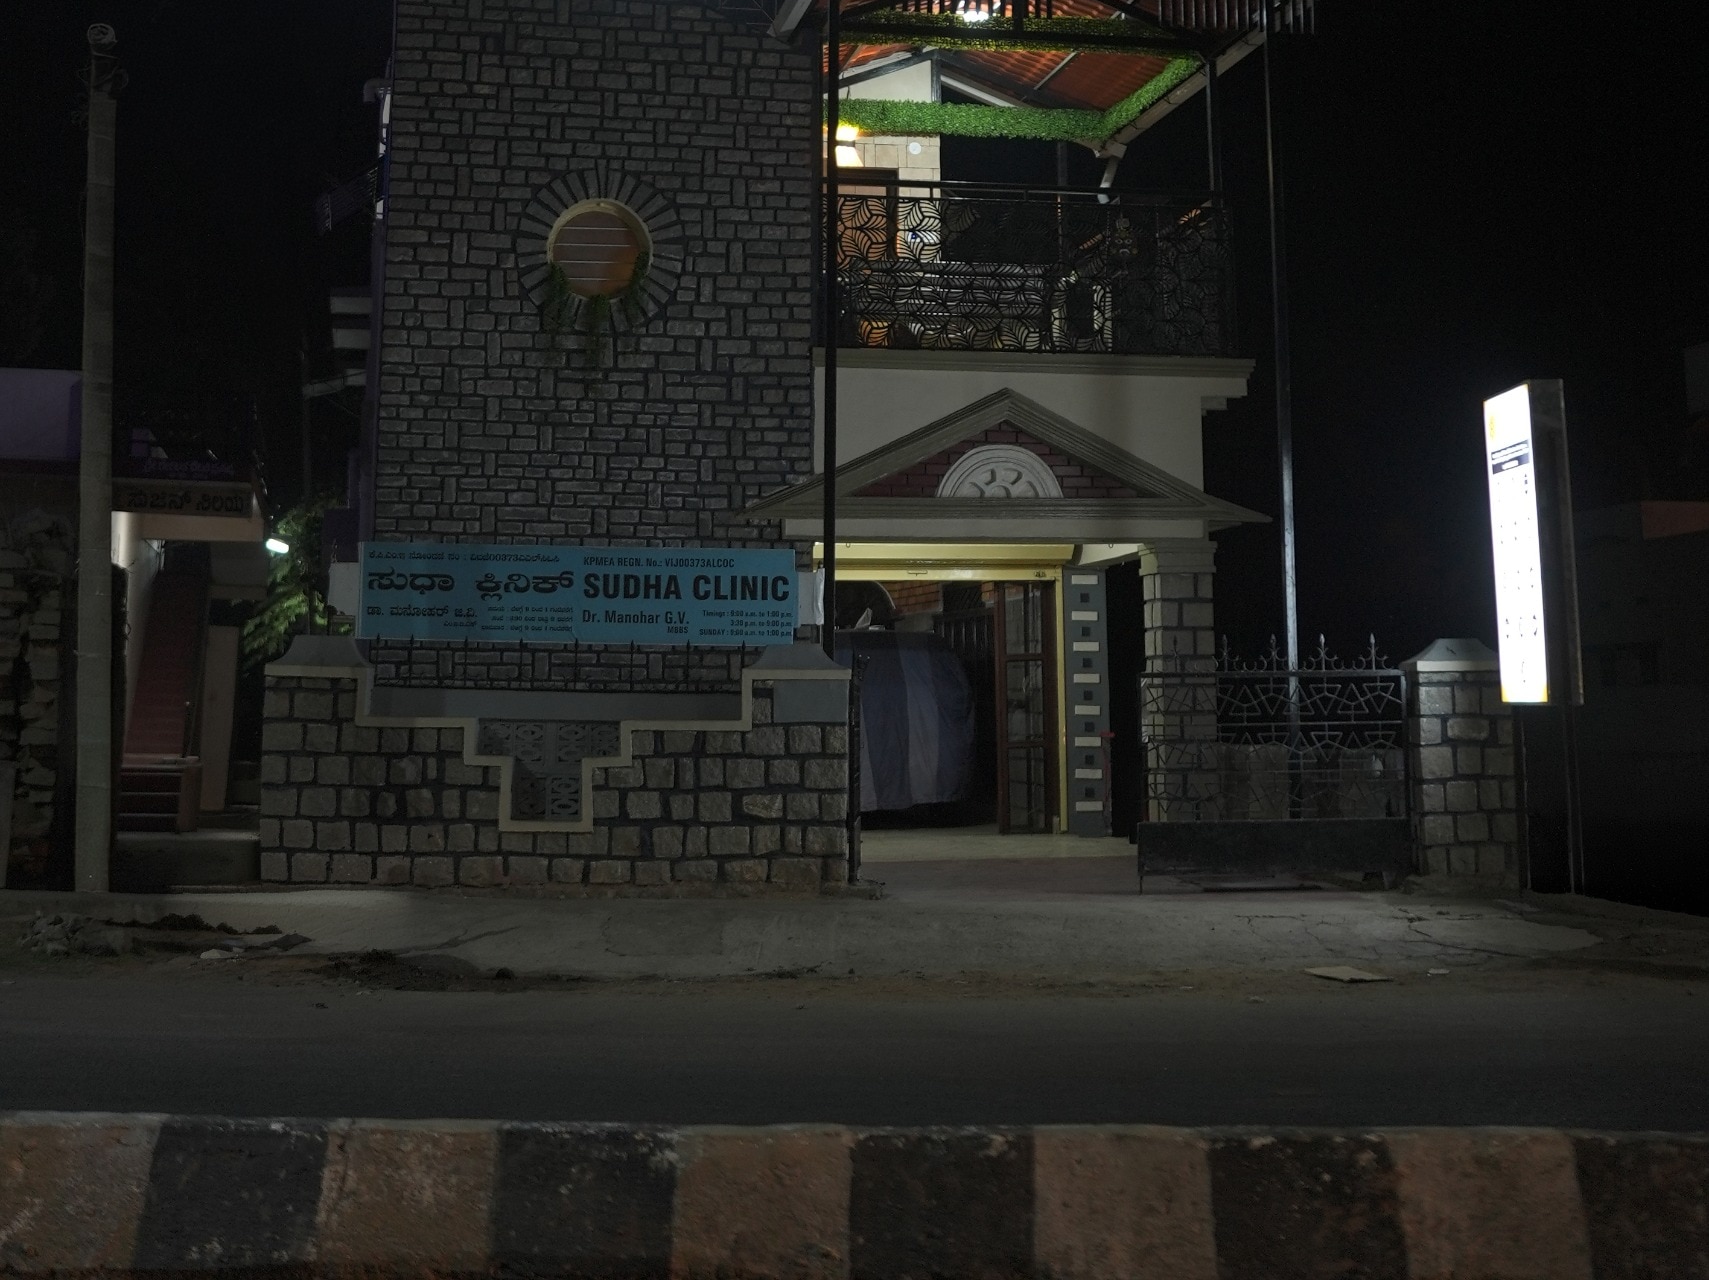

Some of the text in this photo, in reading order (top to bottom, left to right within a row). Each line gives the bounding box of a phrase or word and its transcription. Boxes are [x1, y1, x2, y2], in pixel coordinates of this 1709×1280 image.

[584, 556, 615, 566] KPMEA
[617, 557, 644, 567] REGN.
[368, 567, 574, 601] ಸುಧಾ ಕ್ಲಿನಿಕ್
[583, 573, 789, 601] SUDHA CLINIC
[582, 609, 690, 624] Dr. Manohar G.V.
[667, 626, 689, 634] MBBS
[699, 628, 725, 636] SUNDAY
